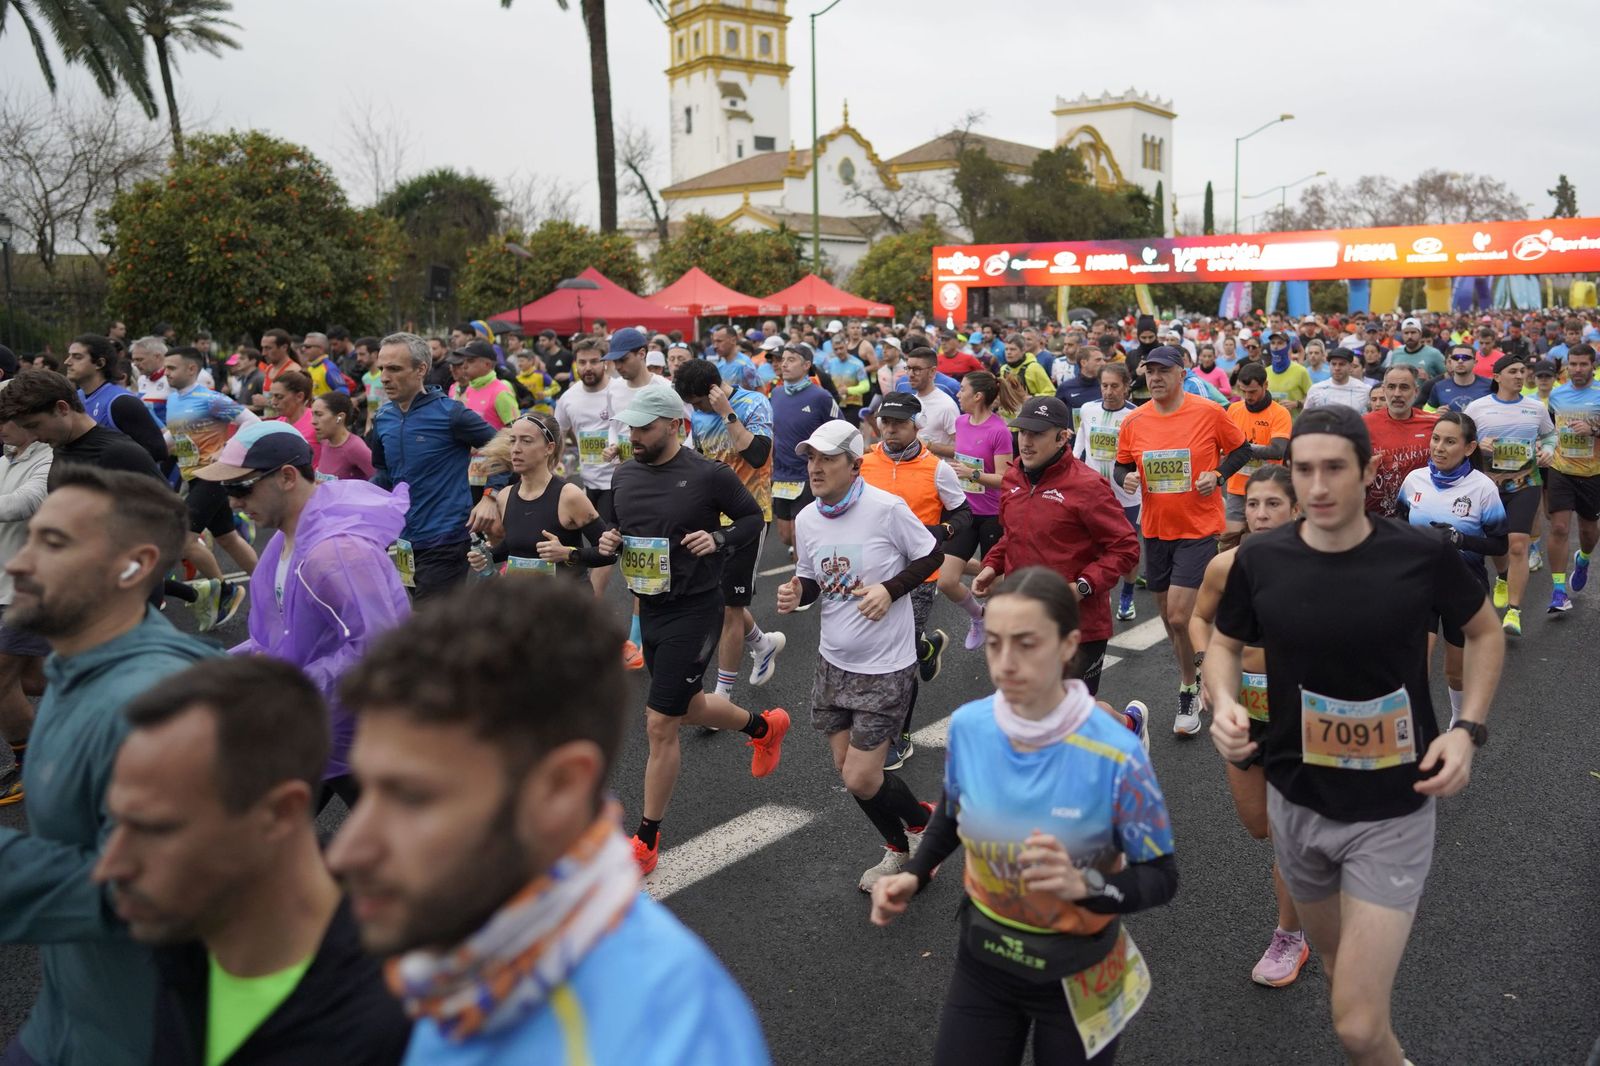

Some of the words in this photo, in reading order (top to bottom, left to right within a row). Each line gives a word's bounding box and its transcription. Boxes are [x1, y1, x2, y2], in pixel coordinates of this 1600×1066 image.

[1393, 448, 1431, 462] MARAT
[1146, 460, 1183, 475] 12632
[625, 551, 656, 570] 9964
[1318, 718, 1385, 746] 7091
